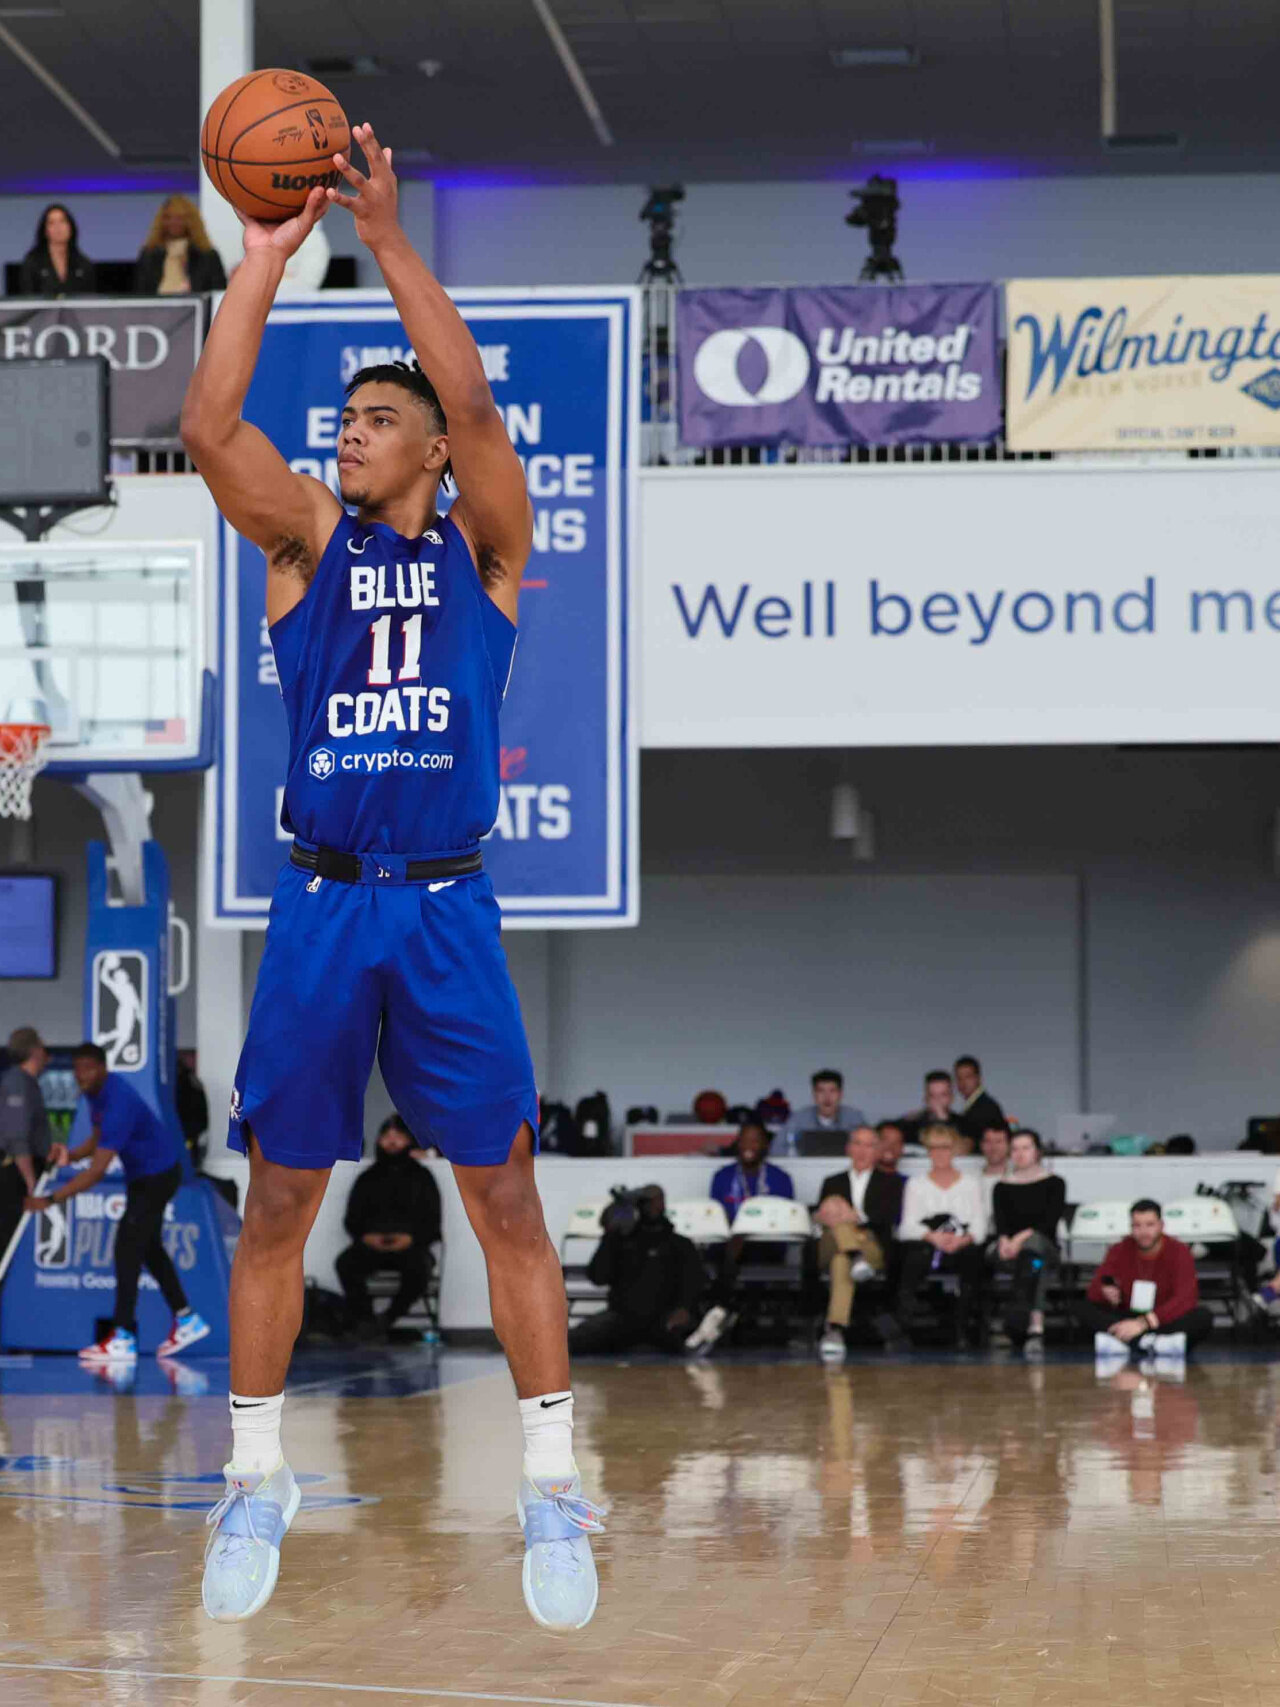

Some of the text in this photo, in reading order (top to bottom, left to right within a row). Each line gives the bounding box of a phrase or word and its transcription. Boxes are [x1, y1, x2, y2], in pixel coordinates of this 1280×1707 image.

[816, 325, 971, 365] United
[815, 364, 983, 403] Rentals
[350, 562, 440, 611] BLUE
[671, 579, 837, 640] Well
[869, 575, 1157, 646] beyond
[367, 613, 423, 685] 11
[327, 687, 451, 738] COATS
[340, 749, 454, 773] crypto.com
